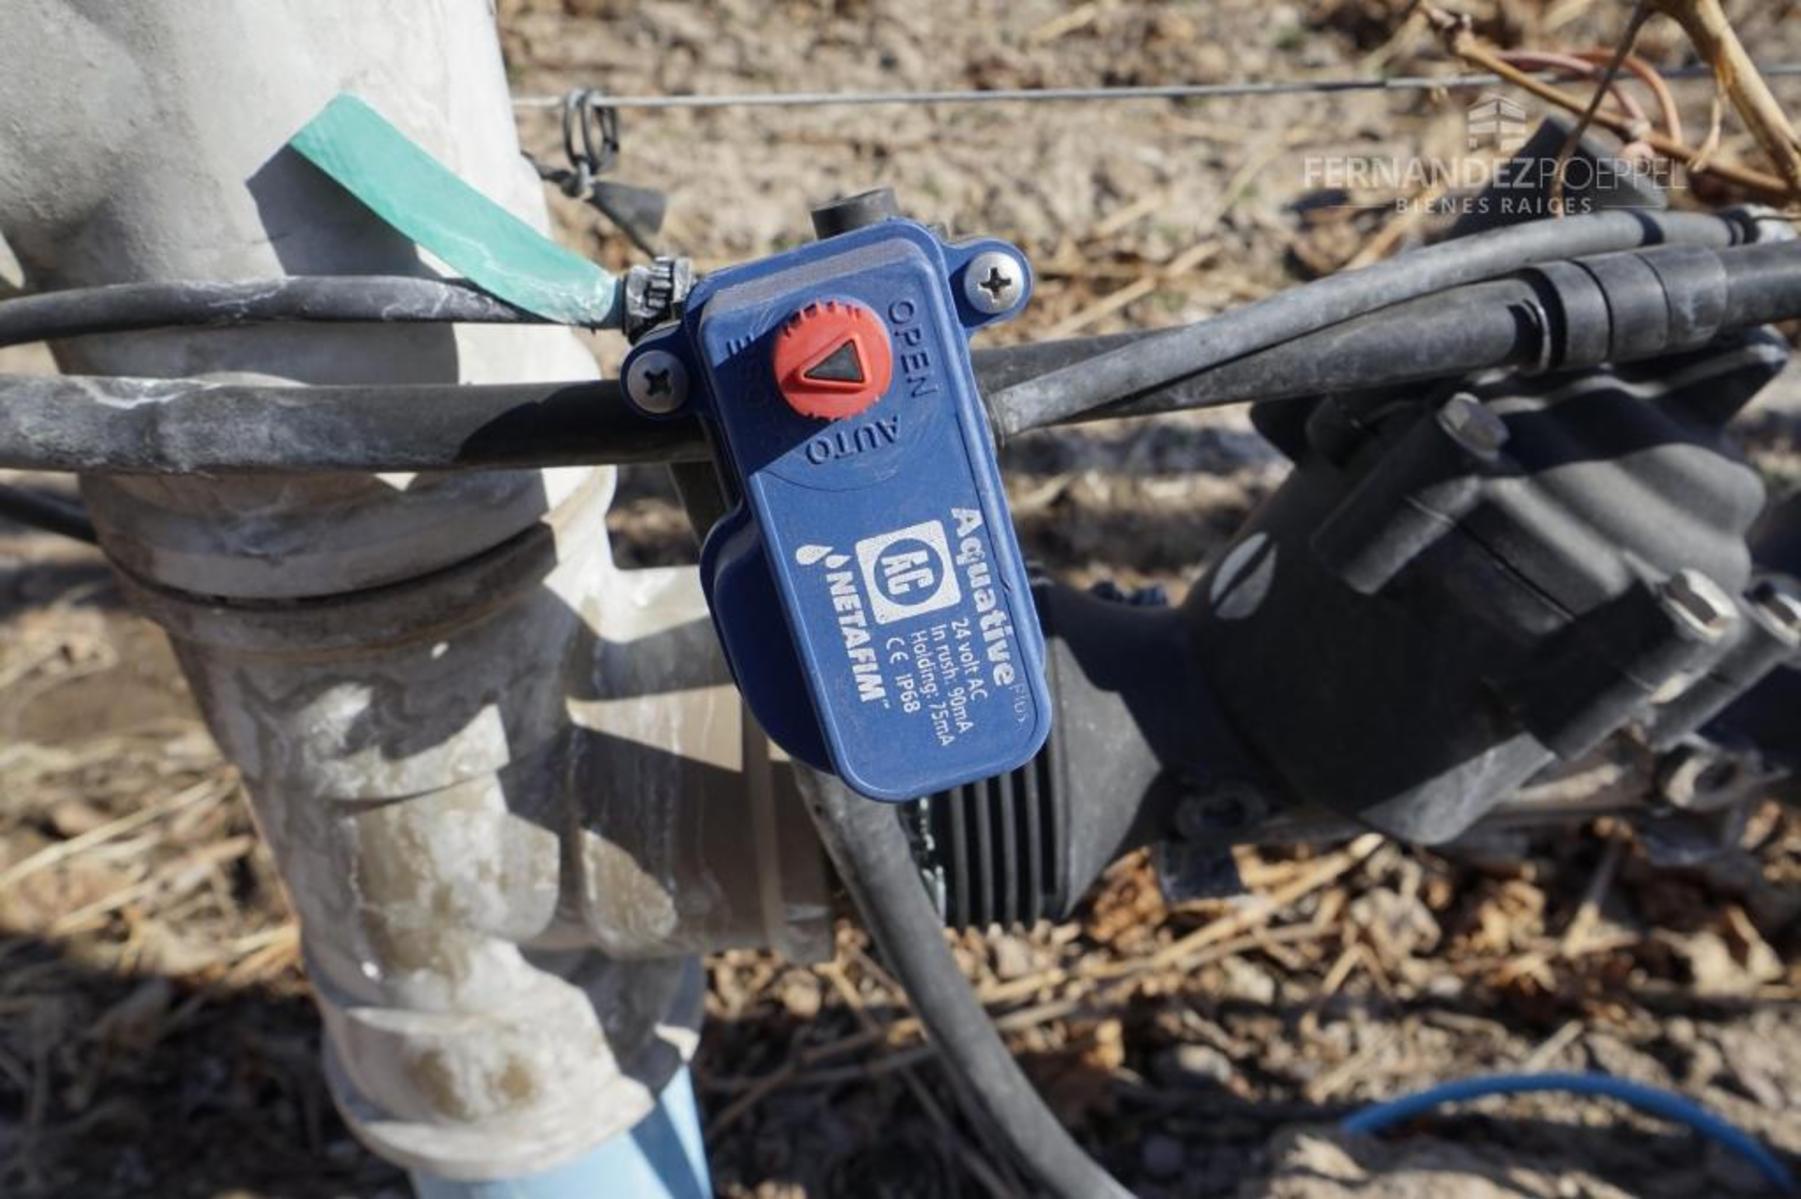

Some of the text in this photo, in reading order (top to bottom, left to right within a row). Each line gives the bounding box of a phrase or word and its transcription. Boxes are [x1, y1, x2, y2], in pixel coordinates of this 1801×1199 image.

[889, 299, 938, 399] OPEN
[805, 415, 900, 465] AUTO
[951, 508, 1015, 686] Aquative
[895, 673, 921, 714] IP68
[910, 631, 956, 747] Holding: 75mA
[931, 624, 975, 734] In rush: 90mA
[951, 618, 988, 701] 24 volt AC
